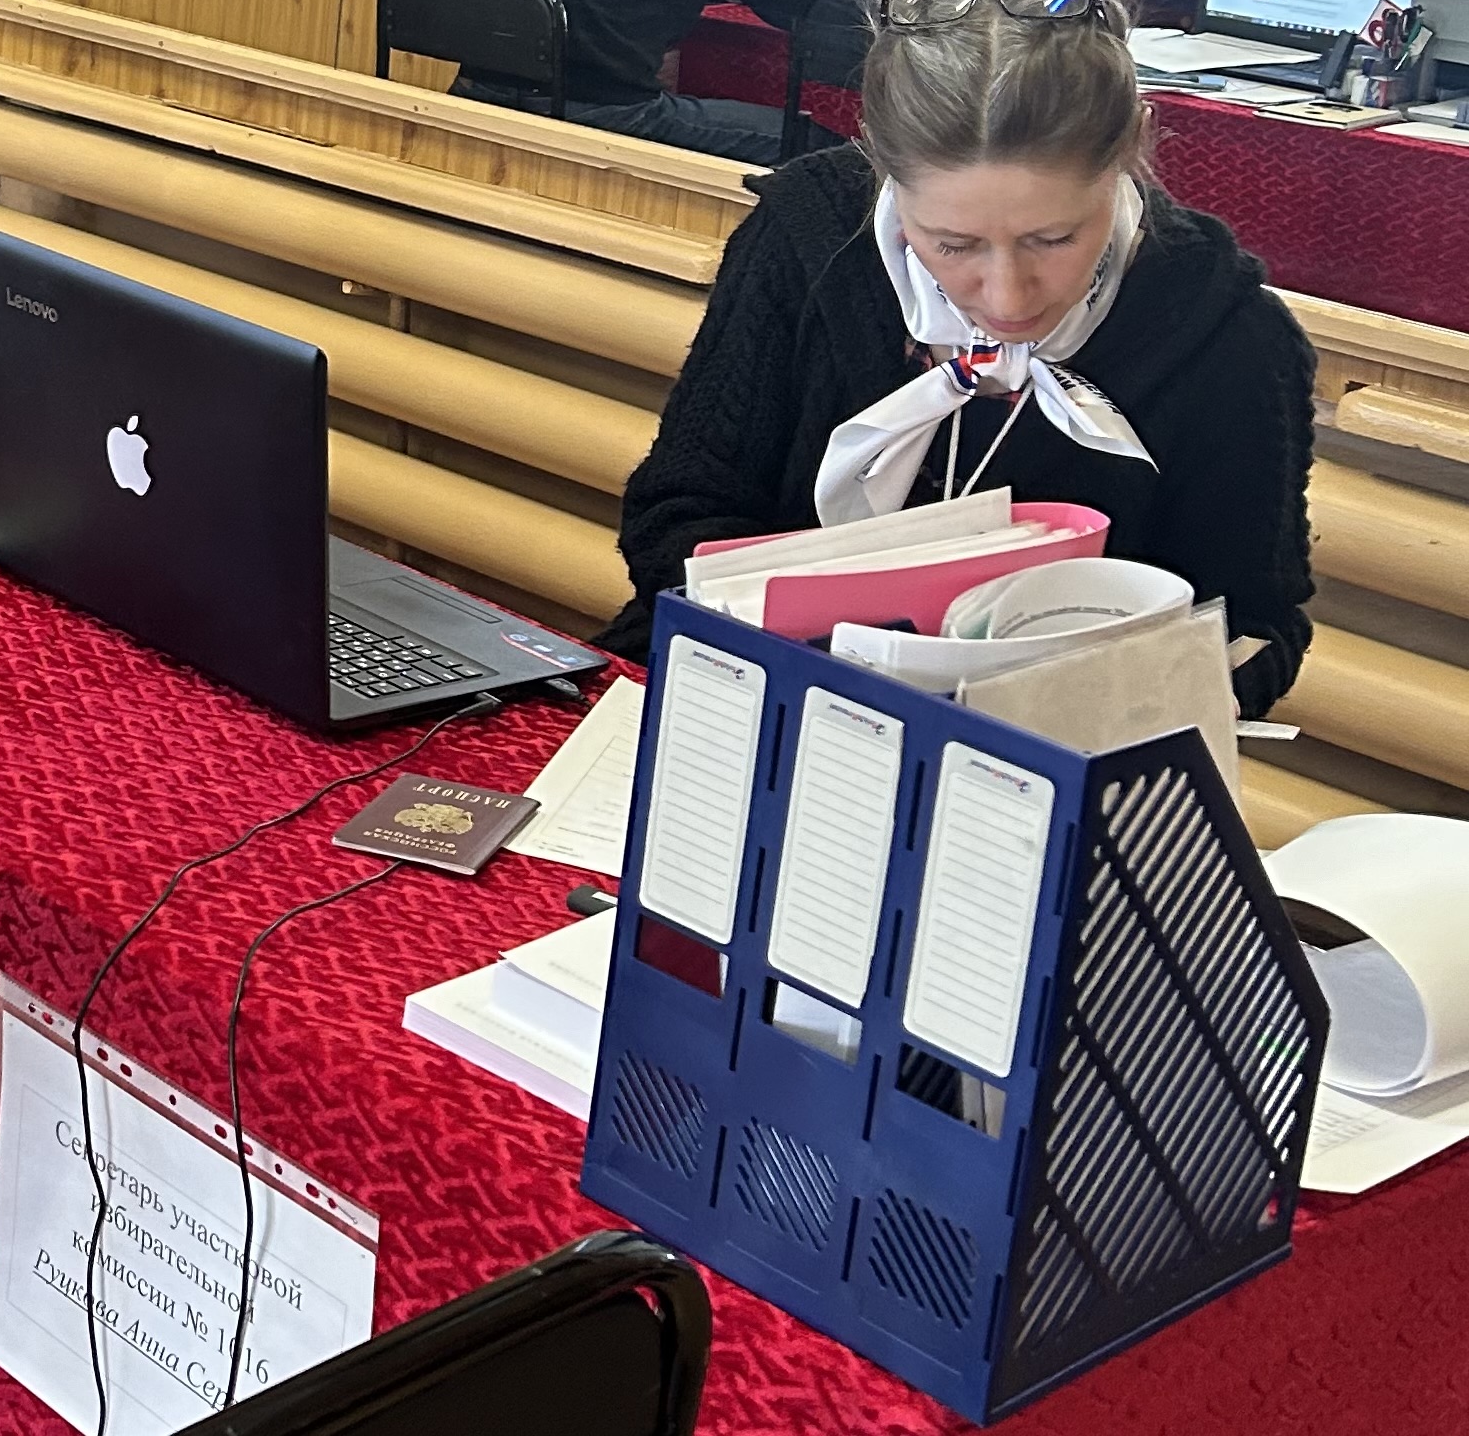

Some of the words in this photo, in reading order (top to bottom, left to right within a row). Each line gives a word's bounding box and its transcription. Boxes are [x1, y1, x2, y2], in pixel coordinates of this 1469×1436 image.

[6, 286, 58, 323] Lenovo
[413, 783, 512, 809] ПАСПОРТ
[72, 1229, 176, 1319] комиссии
[182, 1302, 208, 1342] №
[170, 1203, 303, 1311] участковой
[123, 1318, 180, 1372] Анна
[186, 1361, 237, 1409] Сер
